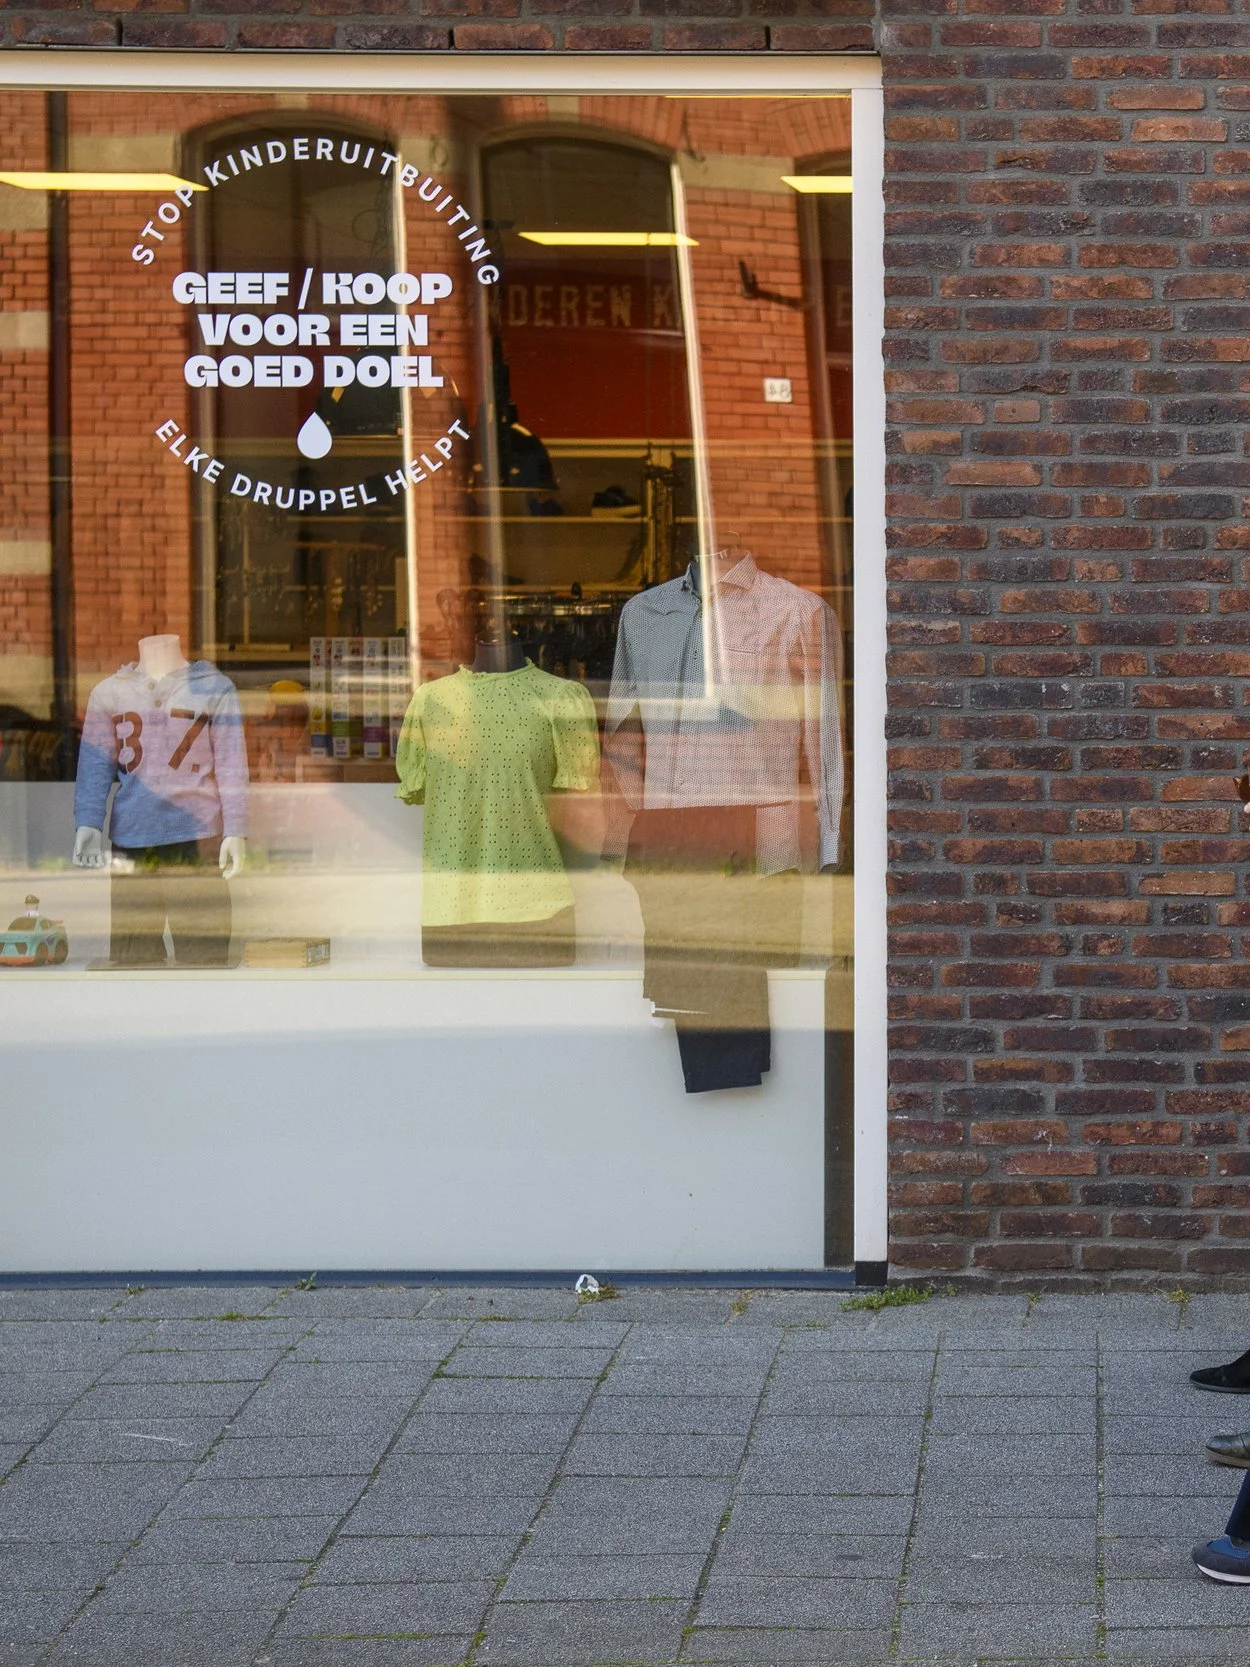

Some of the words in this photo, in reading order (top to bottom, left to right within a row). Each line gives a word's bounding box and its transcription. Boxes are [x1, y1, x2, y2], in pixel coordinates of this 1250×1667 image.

[131, 184, 193, 265] STOP
[204, 138, 499, 285] KINDERUITBUITING
[172, 271, 289, 304] GEEF
[322, 272, 453, 305] KOOP
[198, 313, 331, 346] VOOR
[340, 314, 428, 346] EEN
[184, 355, 314, 388] GOED
[324, 355, 444, 388] DOEL
[155, 419, 225, 483] ELKE
[230, 473, 377, 511] DRUPPEL
[384, 419, 471, 495] HELPT
